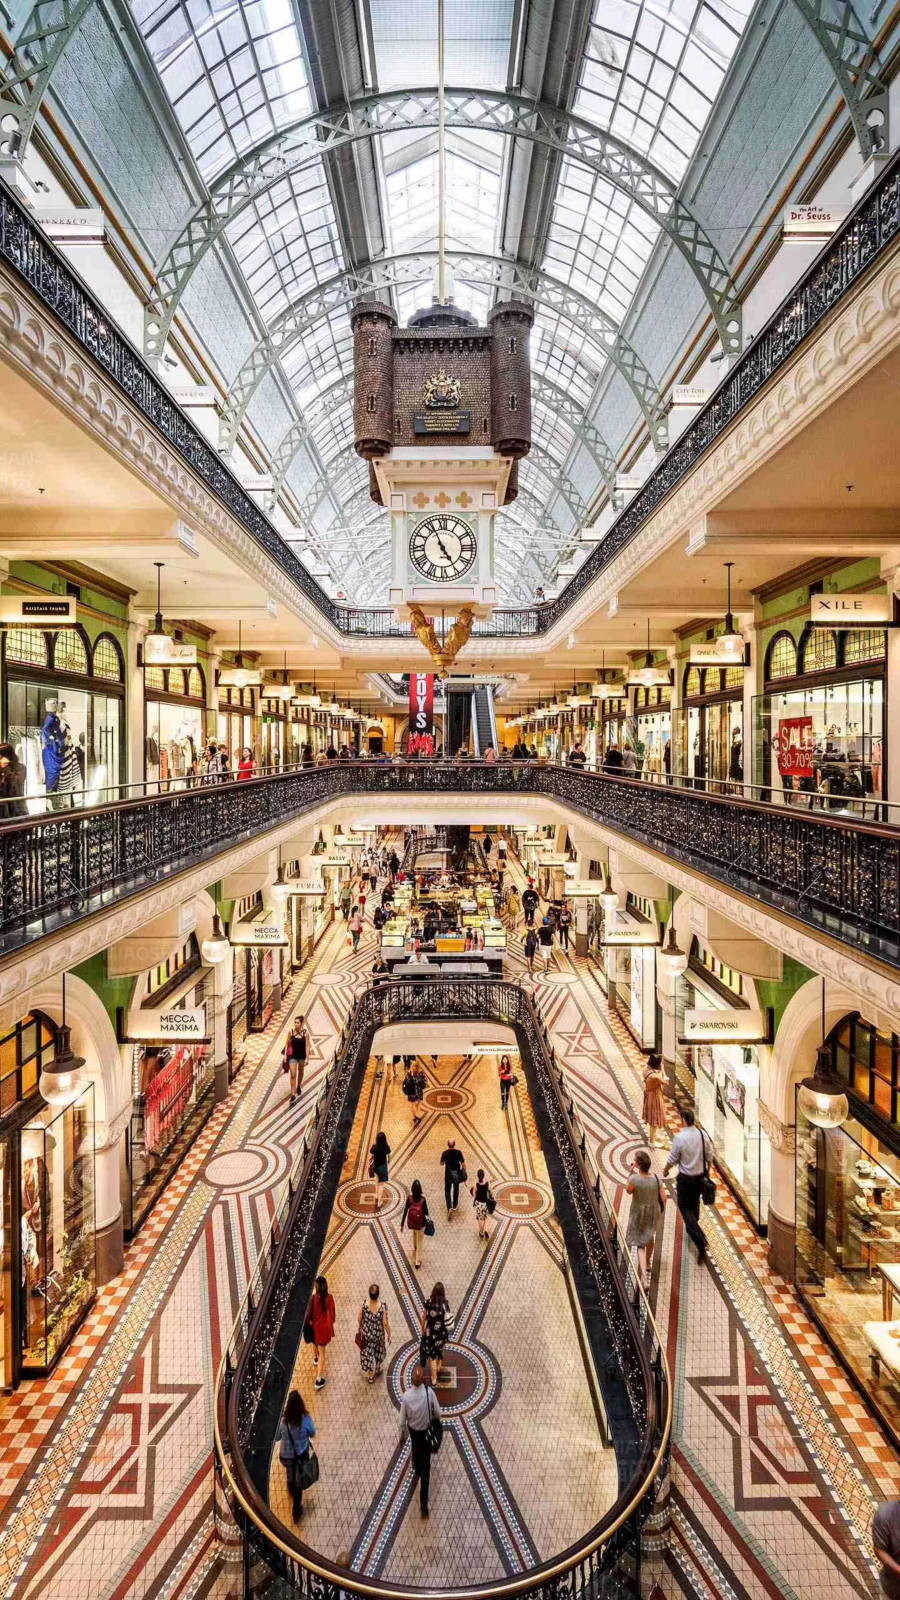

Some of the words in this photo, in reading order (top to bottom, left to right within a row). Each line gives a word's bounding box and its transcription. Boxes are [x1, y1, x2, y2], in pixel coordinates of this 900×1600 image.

[790, 211, 804, 221] Dr.
[806, 211, 831, 221] Seuss
[818, 600, 863, 610] XILE
[781, 724, 814, 752] SALE
[781, 752, 814, 769] 30-70%
[160, 1014, 196, 1023] MECCA
[160, 1023, 200, 1032] MAXIMA
[699, 1022, 739, 1030] SWAROVSKI
